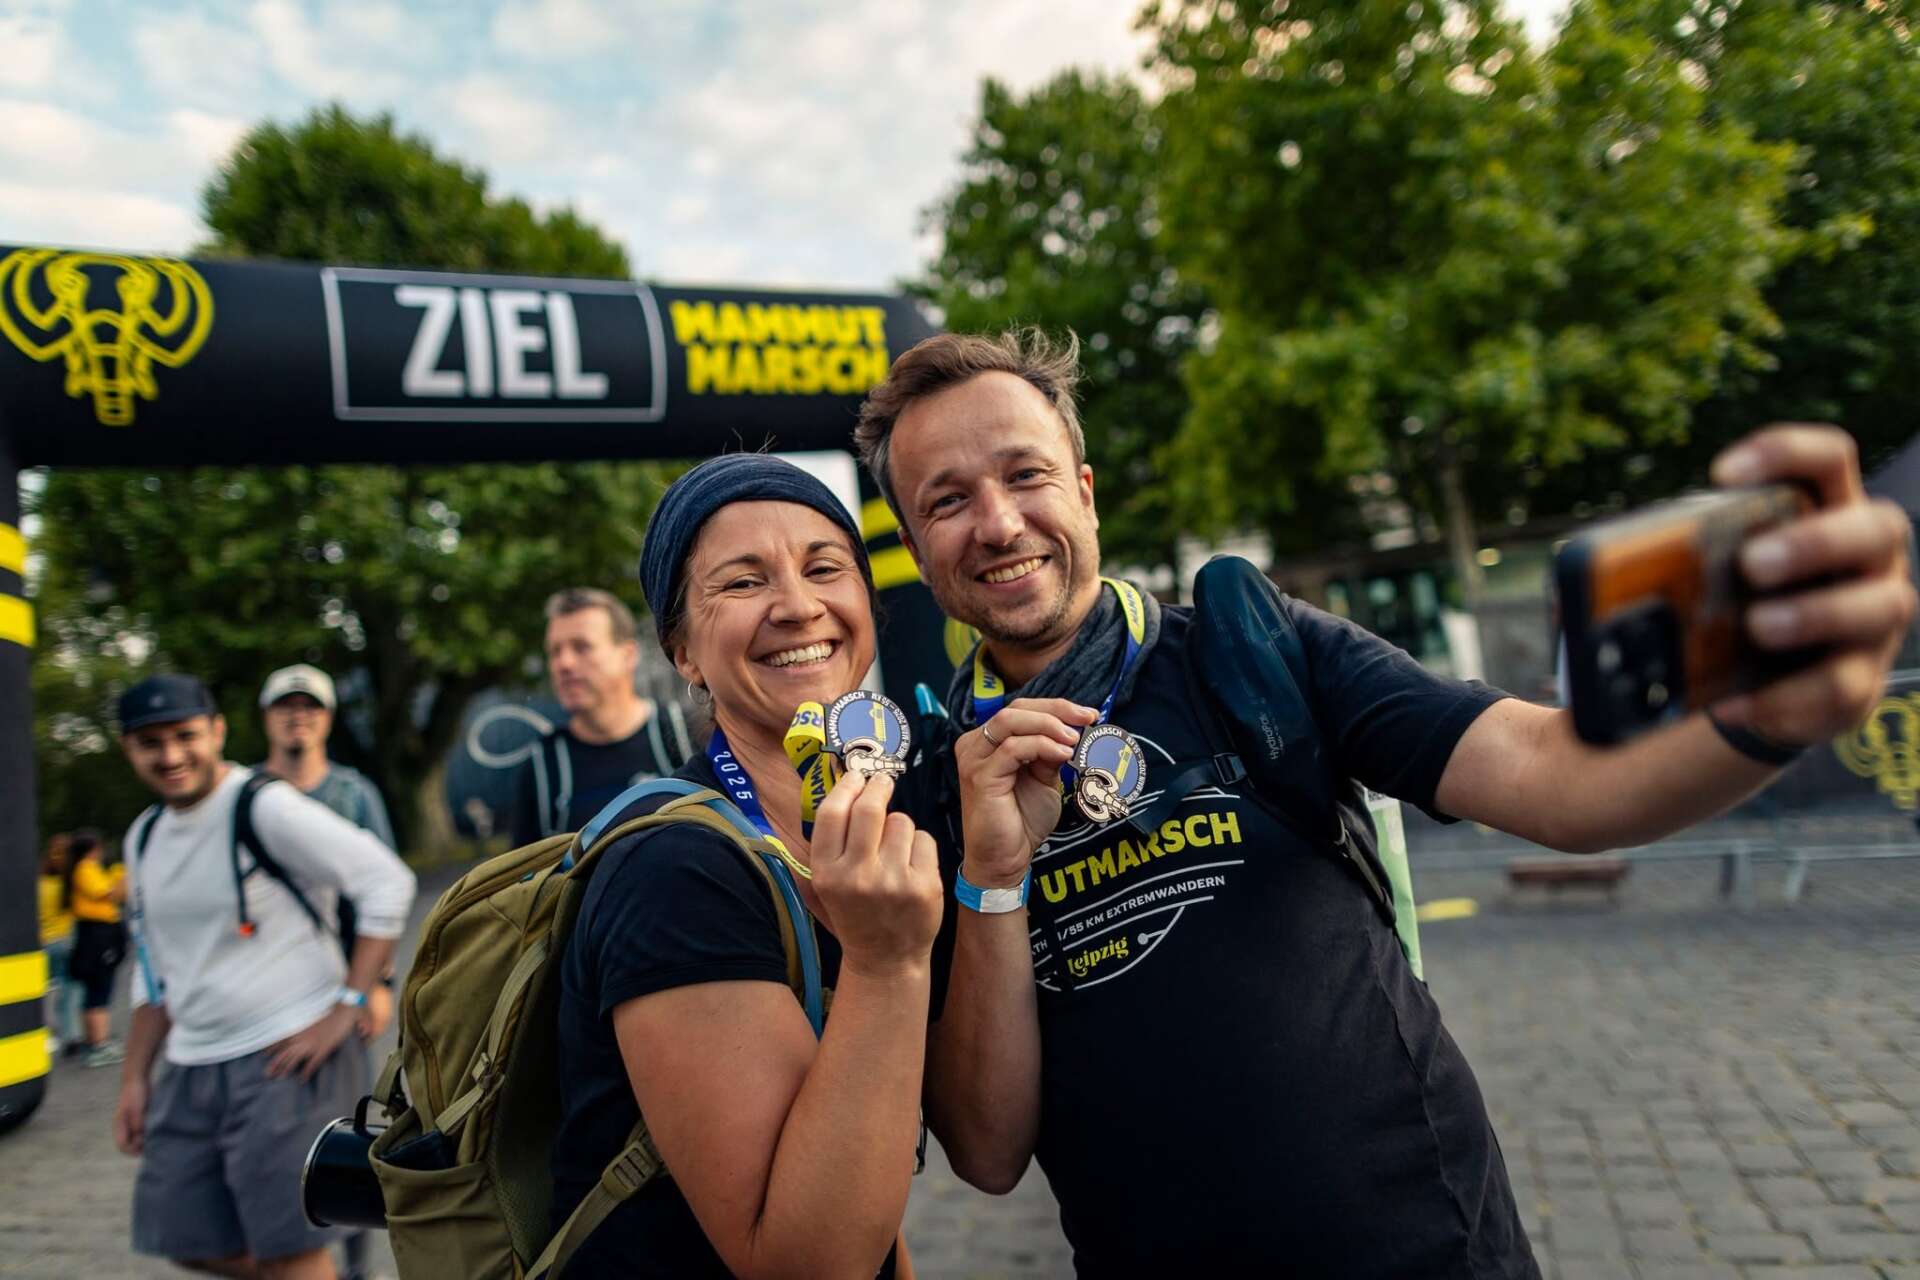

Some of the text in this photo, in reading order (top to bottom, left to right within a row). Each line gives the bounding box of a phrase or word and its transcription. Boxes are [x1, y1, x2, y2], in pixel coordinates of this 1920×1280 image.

[395, 284, 609, 398] ZIEL
[669, 300, 887, 346] MAMMUT
[686, 342, 890, 395] MARSCH
[829, 691, 866, 747] MAMMUTMARSCH
[1079, 727, 1122, 767] MAMMUTMARSCH
[713, 750, 753, 801] 2025
[1036, 811, 1242, 903] UTMARSCH
[1085, 913, 1104, 929] KM
[1106, 875, 1226, 919] EXTREMWANDERN
[1066, 936, 1130, 977] Leipzig
